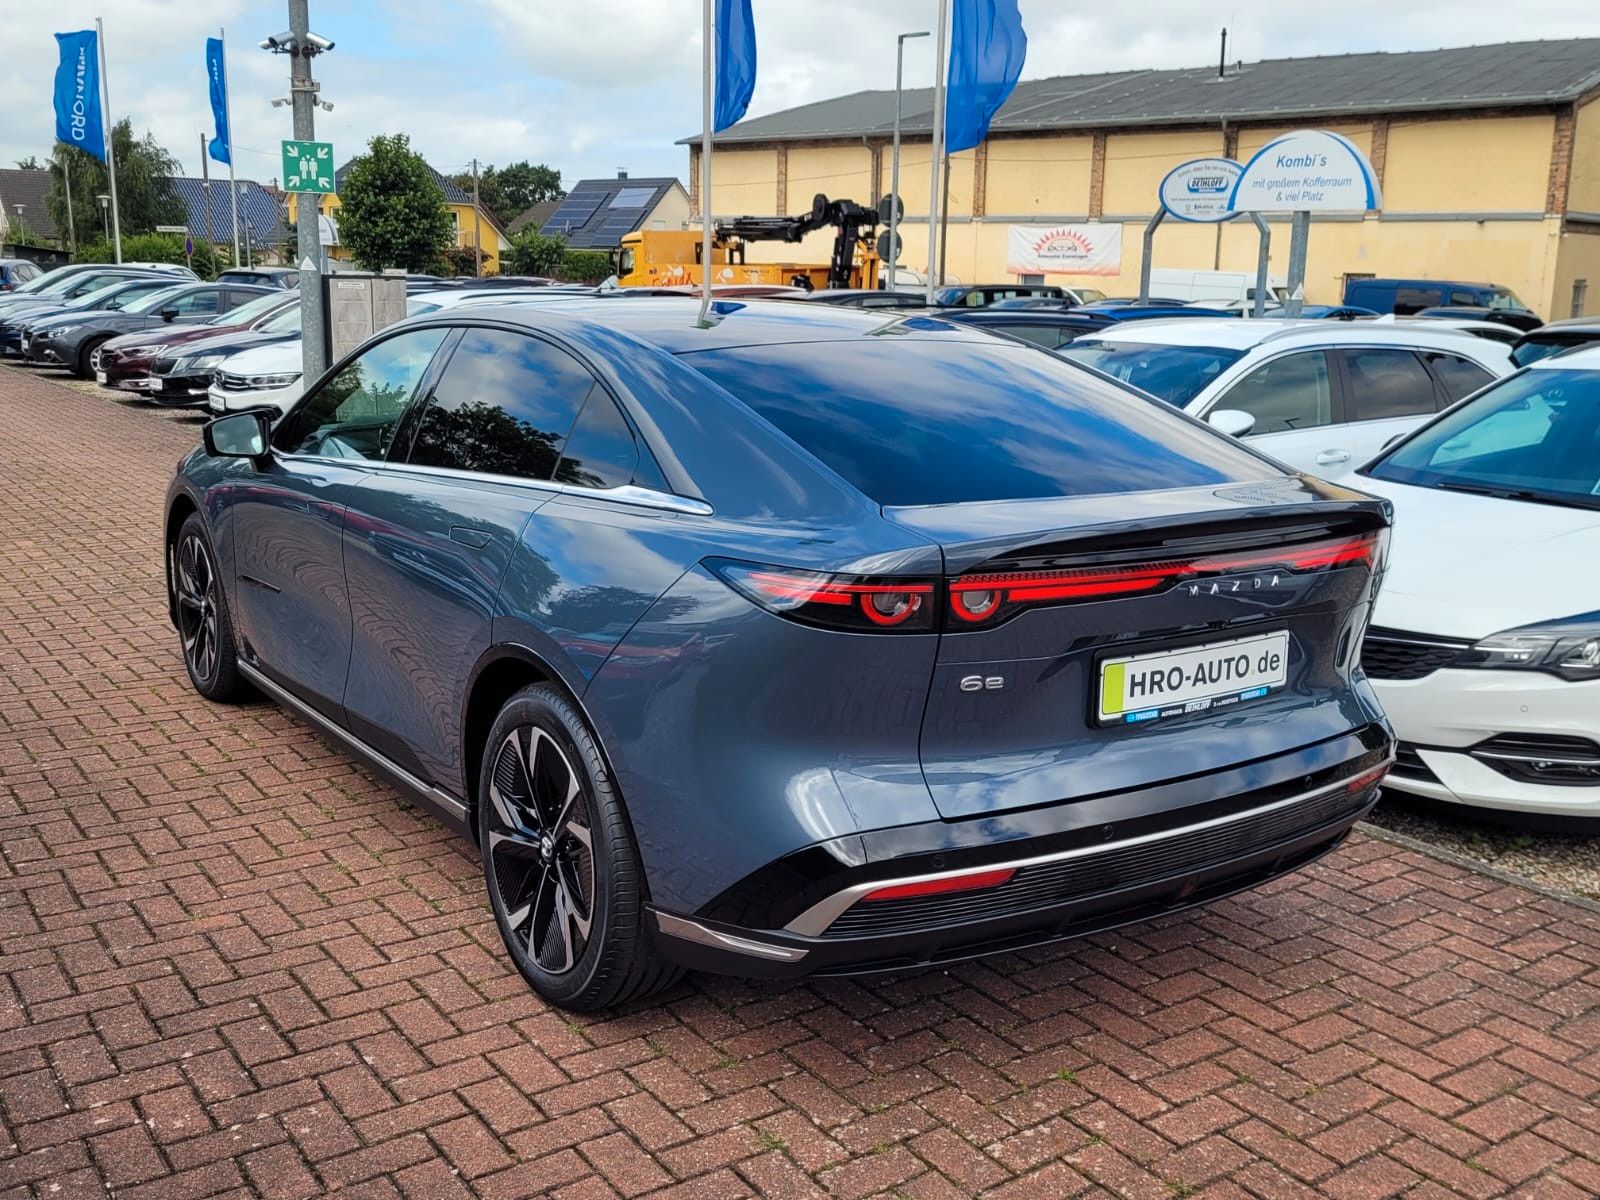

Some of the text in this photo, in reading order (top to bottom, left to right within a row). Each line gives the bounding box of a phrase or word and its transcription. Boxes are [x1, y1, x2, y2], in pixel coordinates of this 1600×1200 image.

[1252, 176, 1353, 191] mit großem Kofferraum
[1275, 190, 1325, 202] & viel Platz
[1189, 575, 1280, 597] MAZDA
